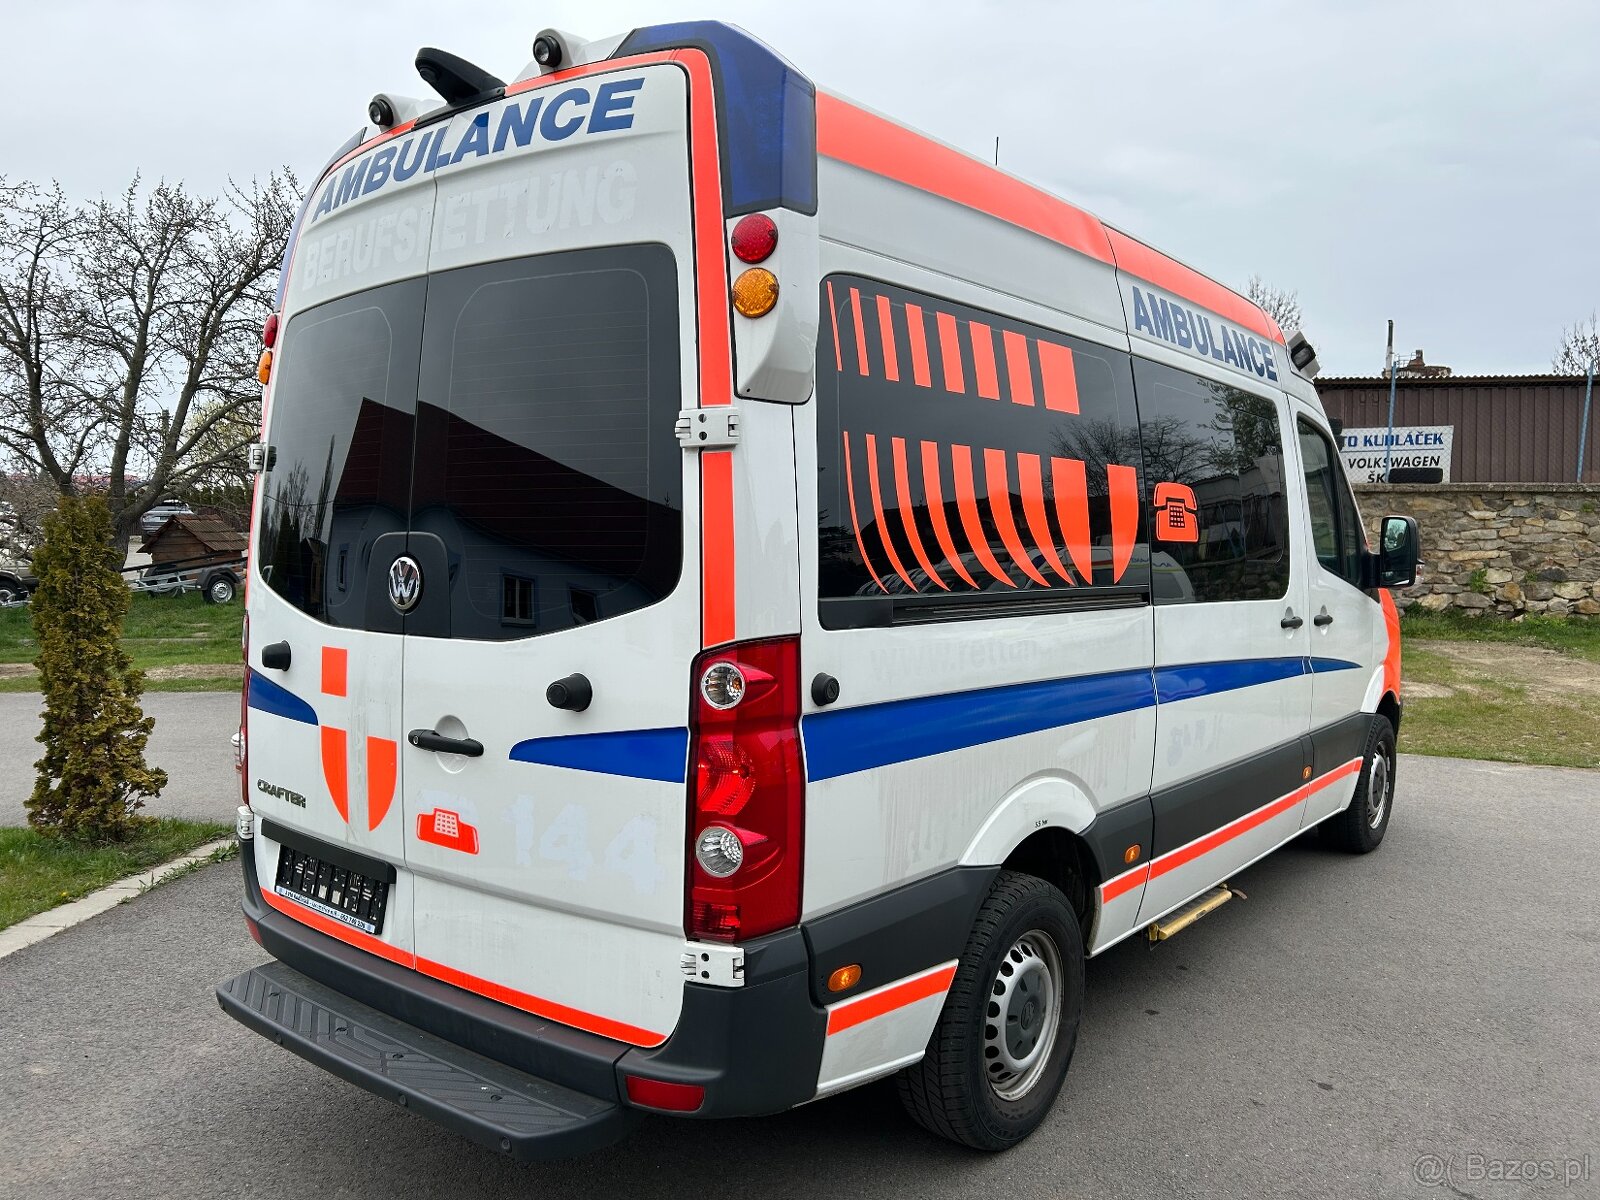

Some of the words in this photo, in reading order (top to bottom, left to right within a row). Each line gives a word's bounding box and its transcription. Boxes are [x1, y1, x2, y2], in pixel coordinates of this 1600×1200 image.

[311, 78, 645, 223] AMBULANCE
[1132, 285, 1278, 382] AMBULANCE
[257, 779, 307, 809] CRAFTER
